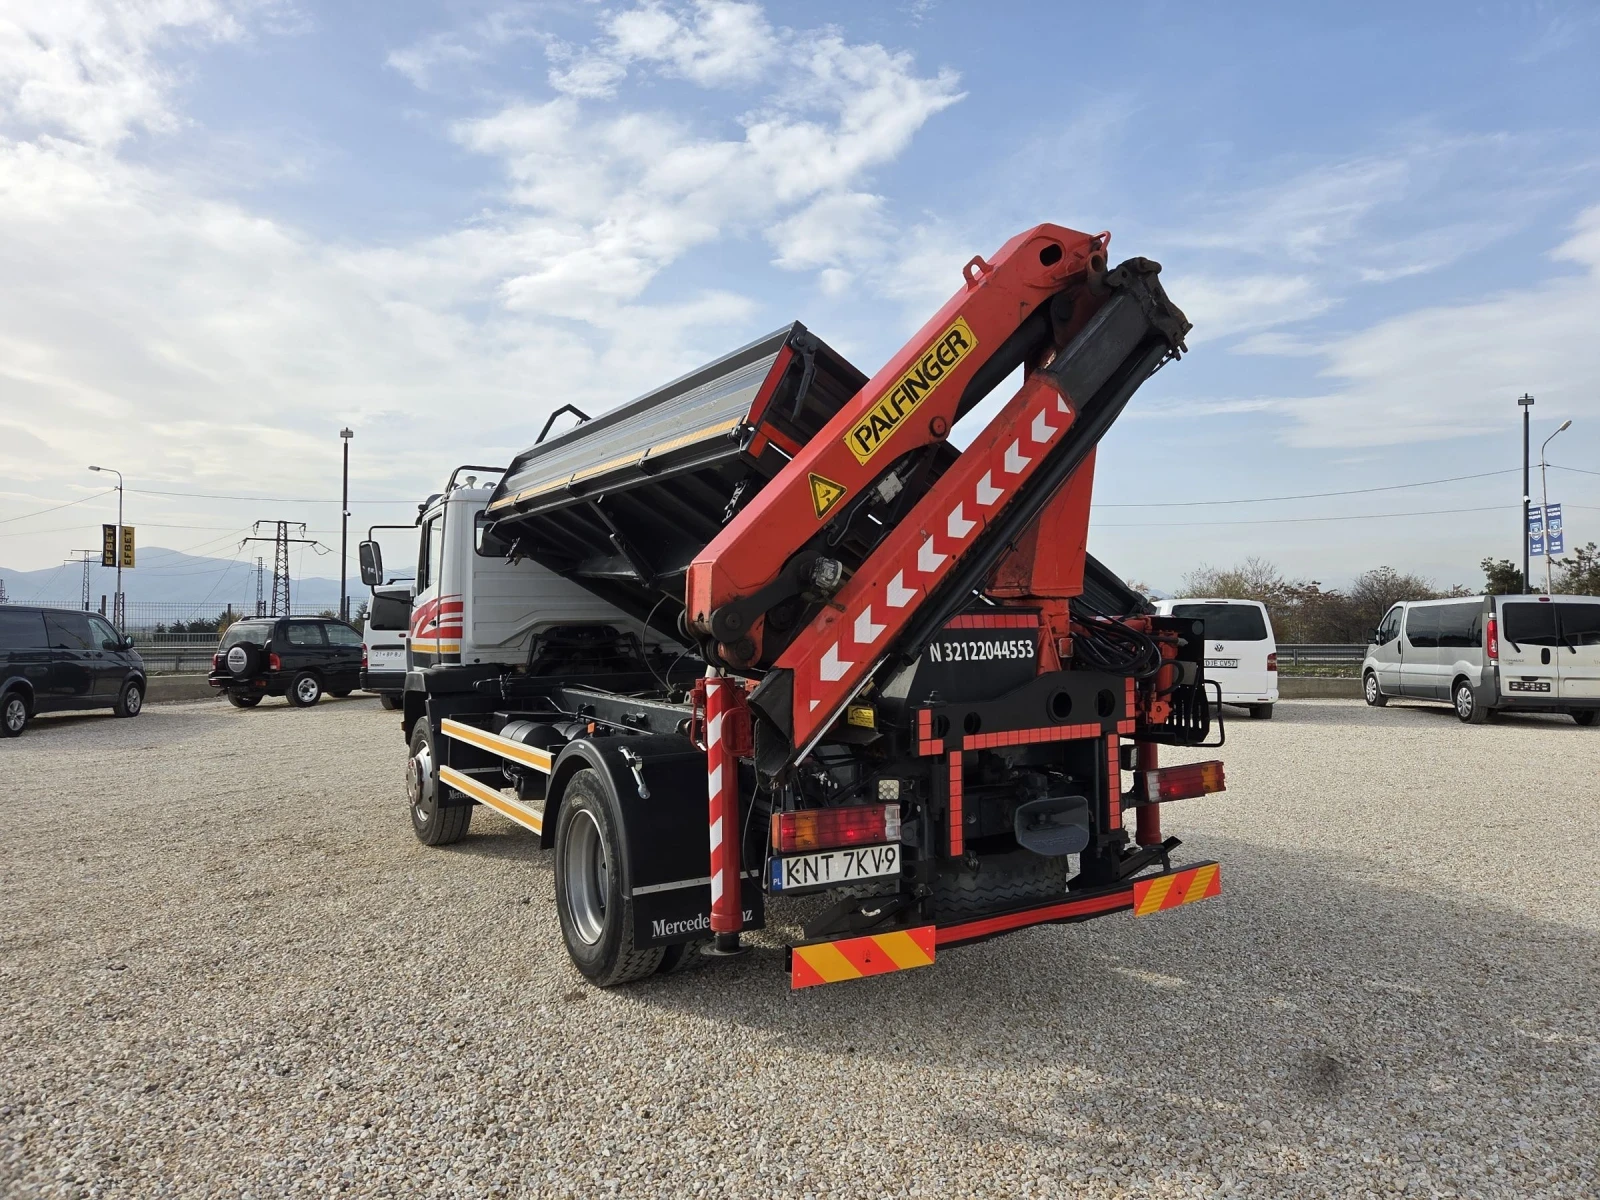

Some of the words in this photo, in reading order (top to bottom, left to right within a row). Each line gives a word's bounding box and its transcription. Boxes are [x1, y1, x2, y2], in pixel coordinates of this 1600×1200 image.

[853, 329, 969, 453] PALFINGER
[105, 527, 114, 565] EFBET
[124, 529, 132, 566] EFBET
[929, 642, 942, 662] N
[943, 639, 1035, 662] 32122044553
[772, 878, 782, 886] PL
[786, 854, 834, 886] KNT
[843, 847, 896, 878] 7KV9
